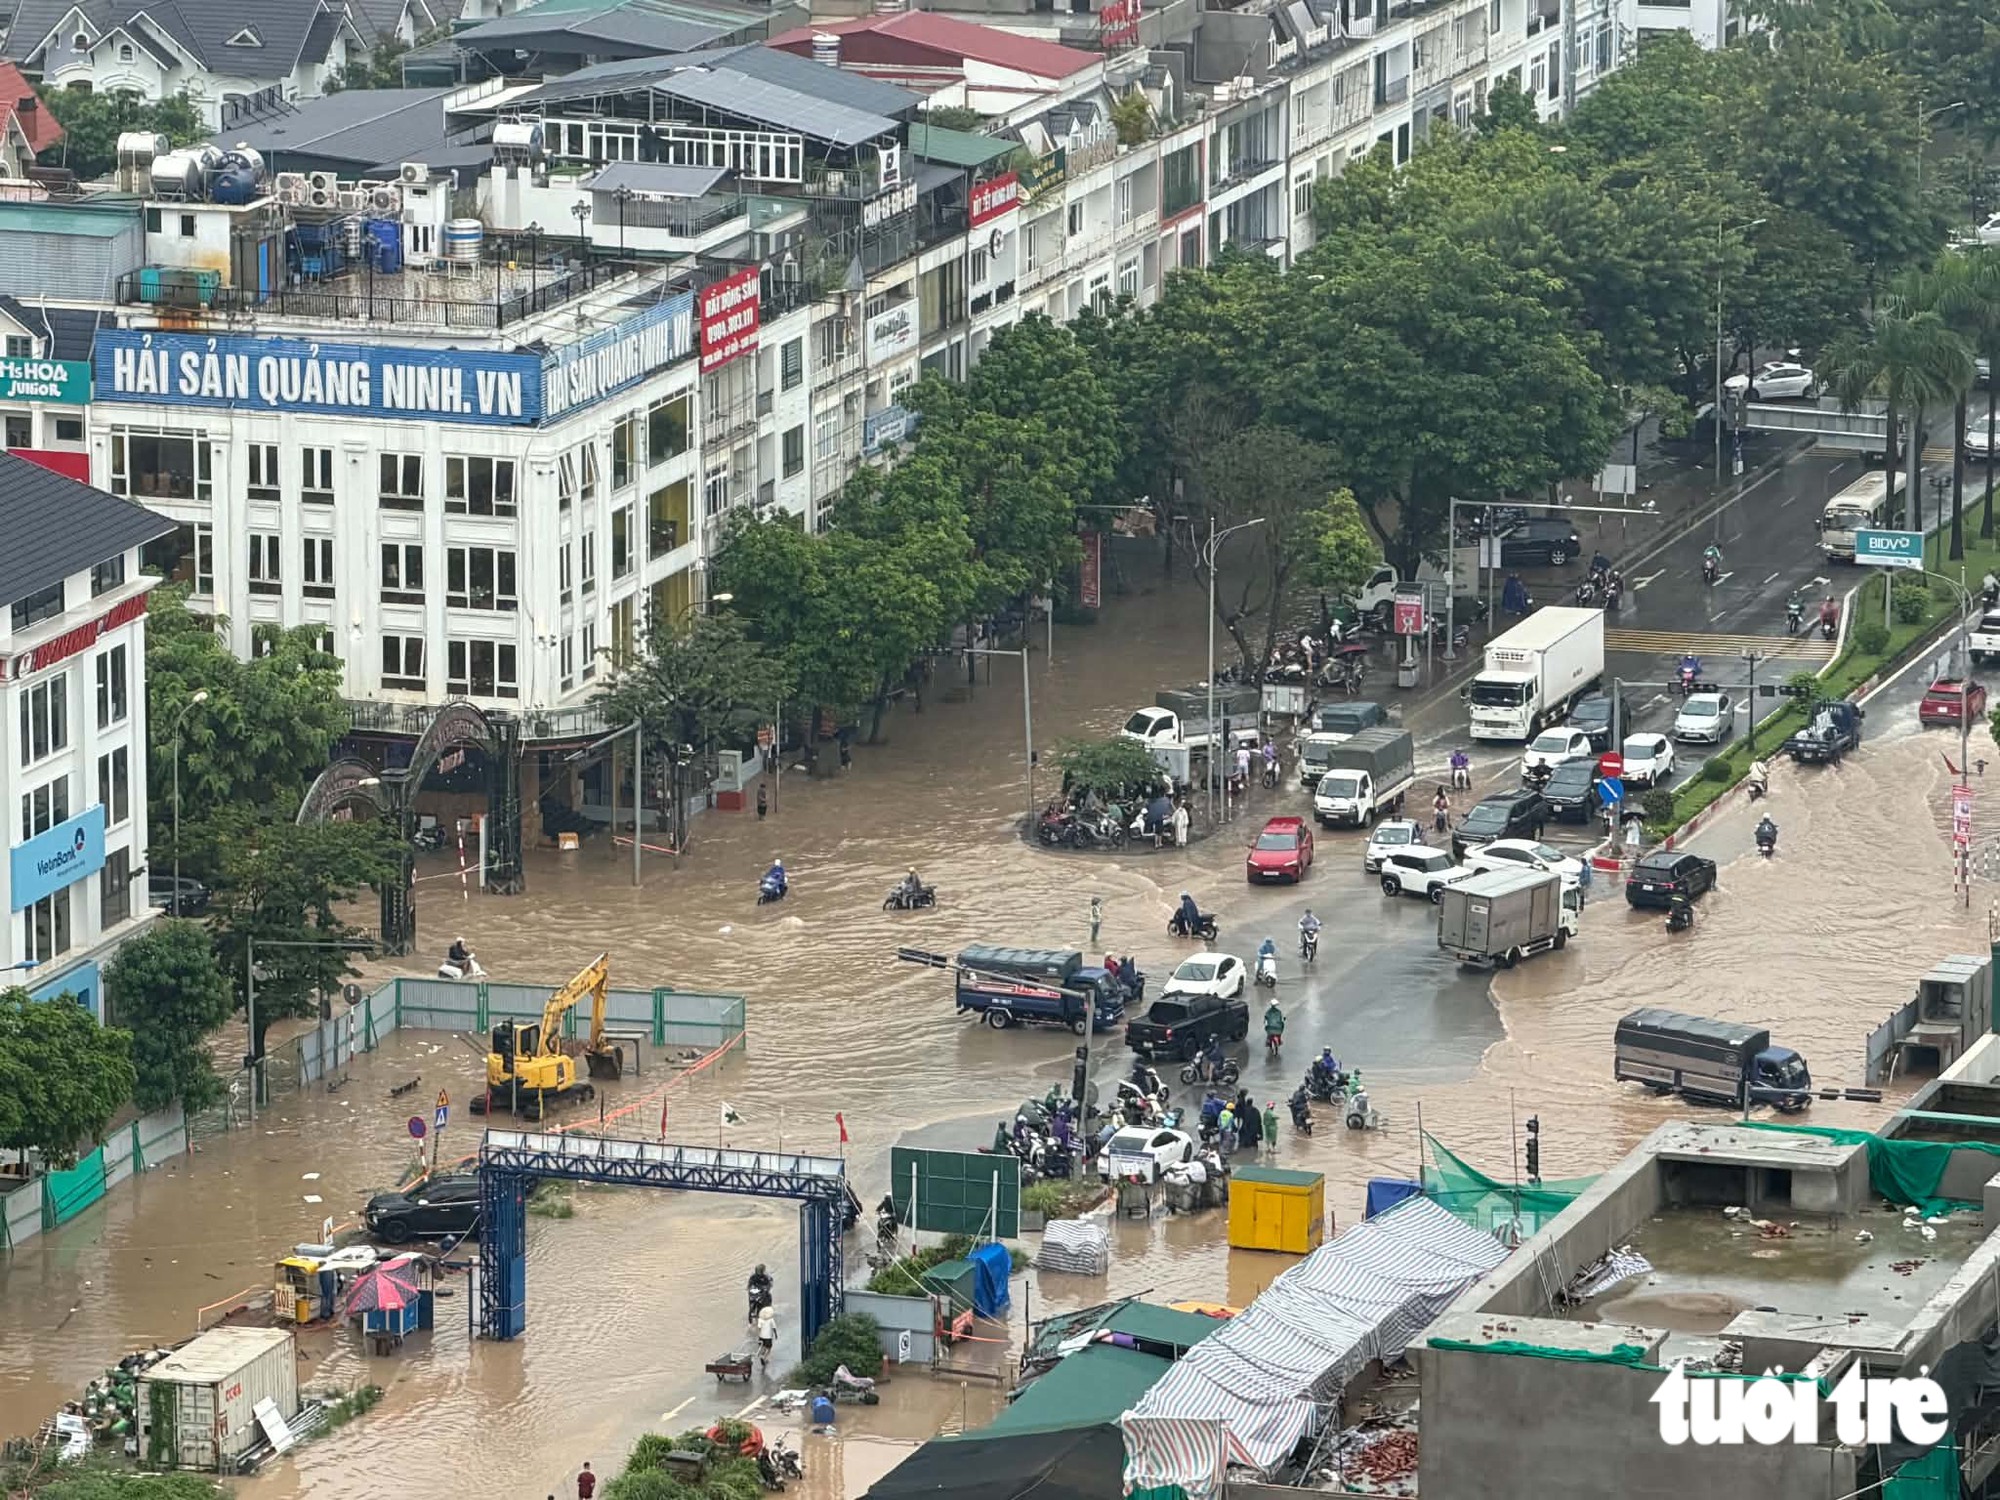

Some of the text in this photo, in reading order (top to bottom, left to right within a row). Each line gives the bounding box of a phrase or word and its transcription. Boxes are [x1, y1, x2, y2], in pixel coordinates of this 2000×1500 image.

[23, 361, 68, 381] HOA
[114, 334, 523, 417] HẢI SẢN QUẢNG NINH.VN
[1869, 537, 1900, 550] BIDV
